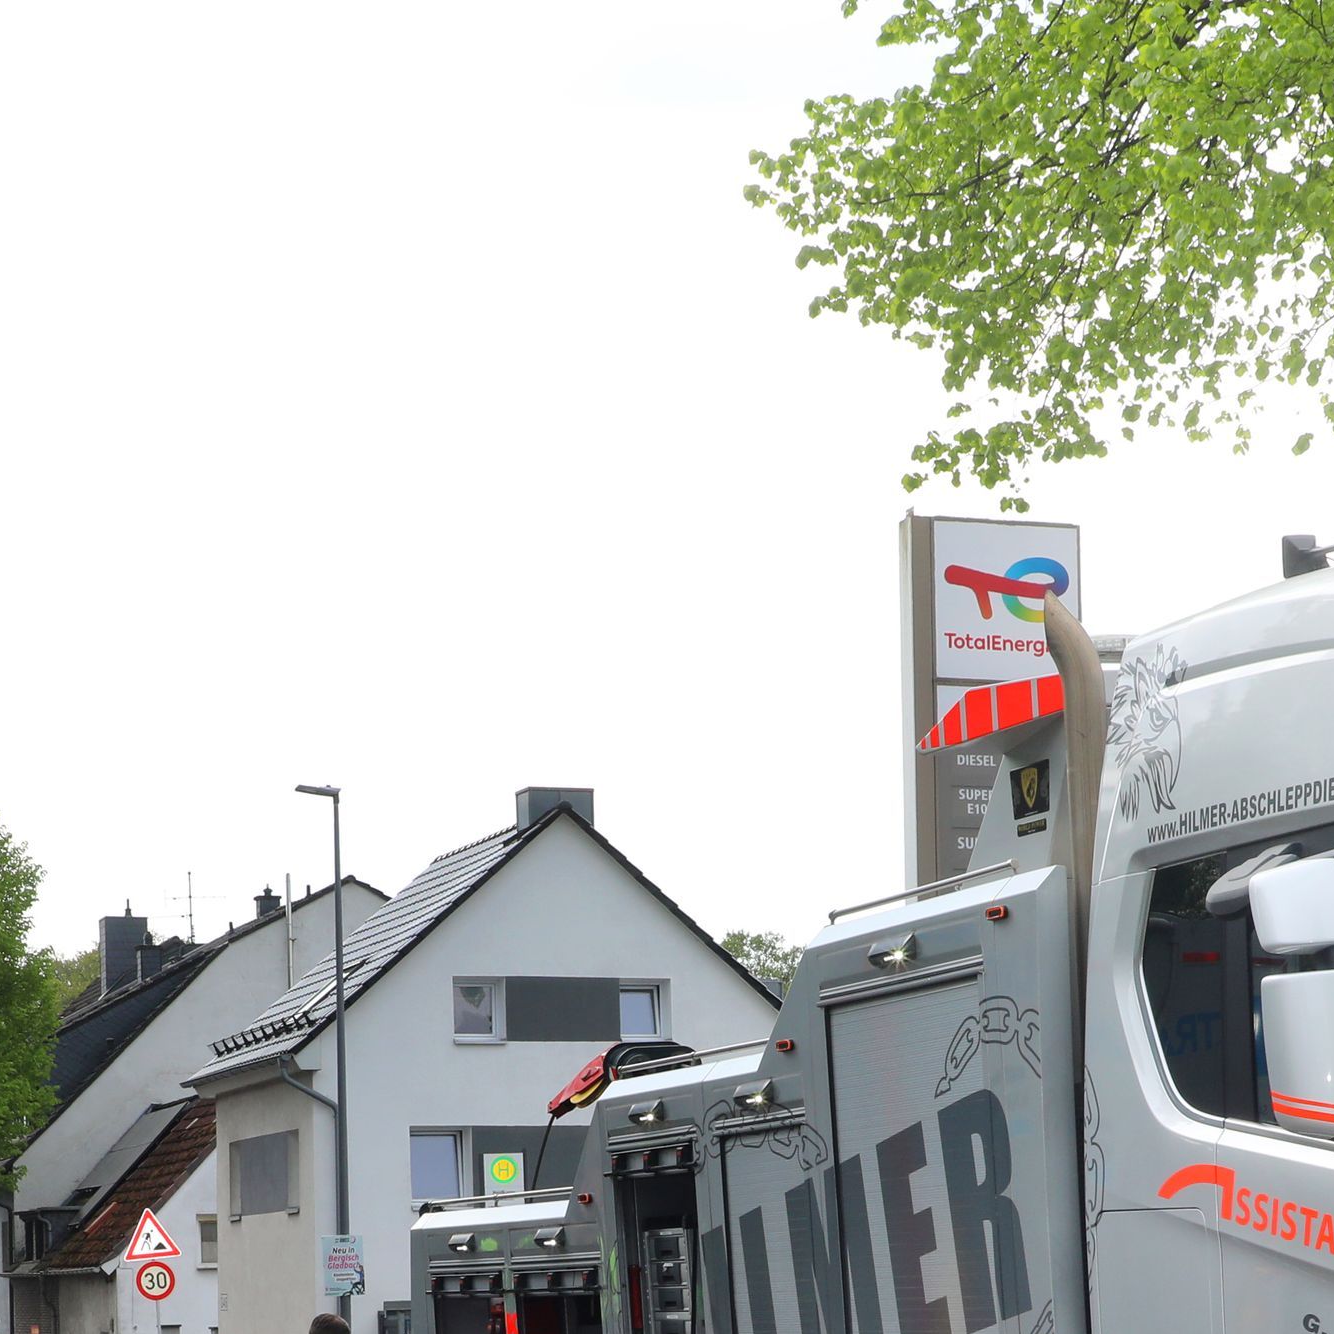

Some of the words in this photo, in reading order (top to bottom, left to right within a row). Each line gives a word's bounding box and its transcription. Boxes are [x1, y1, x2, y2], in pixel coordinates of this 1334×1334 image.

[957, 754, 997, 767] DIESEL
[957, 836, 978, 849] SU
[348, 1246, 355, 1254] in
[328, 1254, 359, 1263] Bergisch
[144, 1271, 167, 1290] 30
